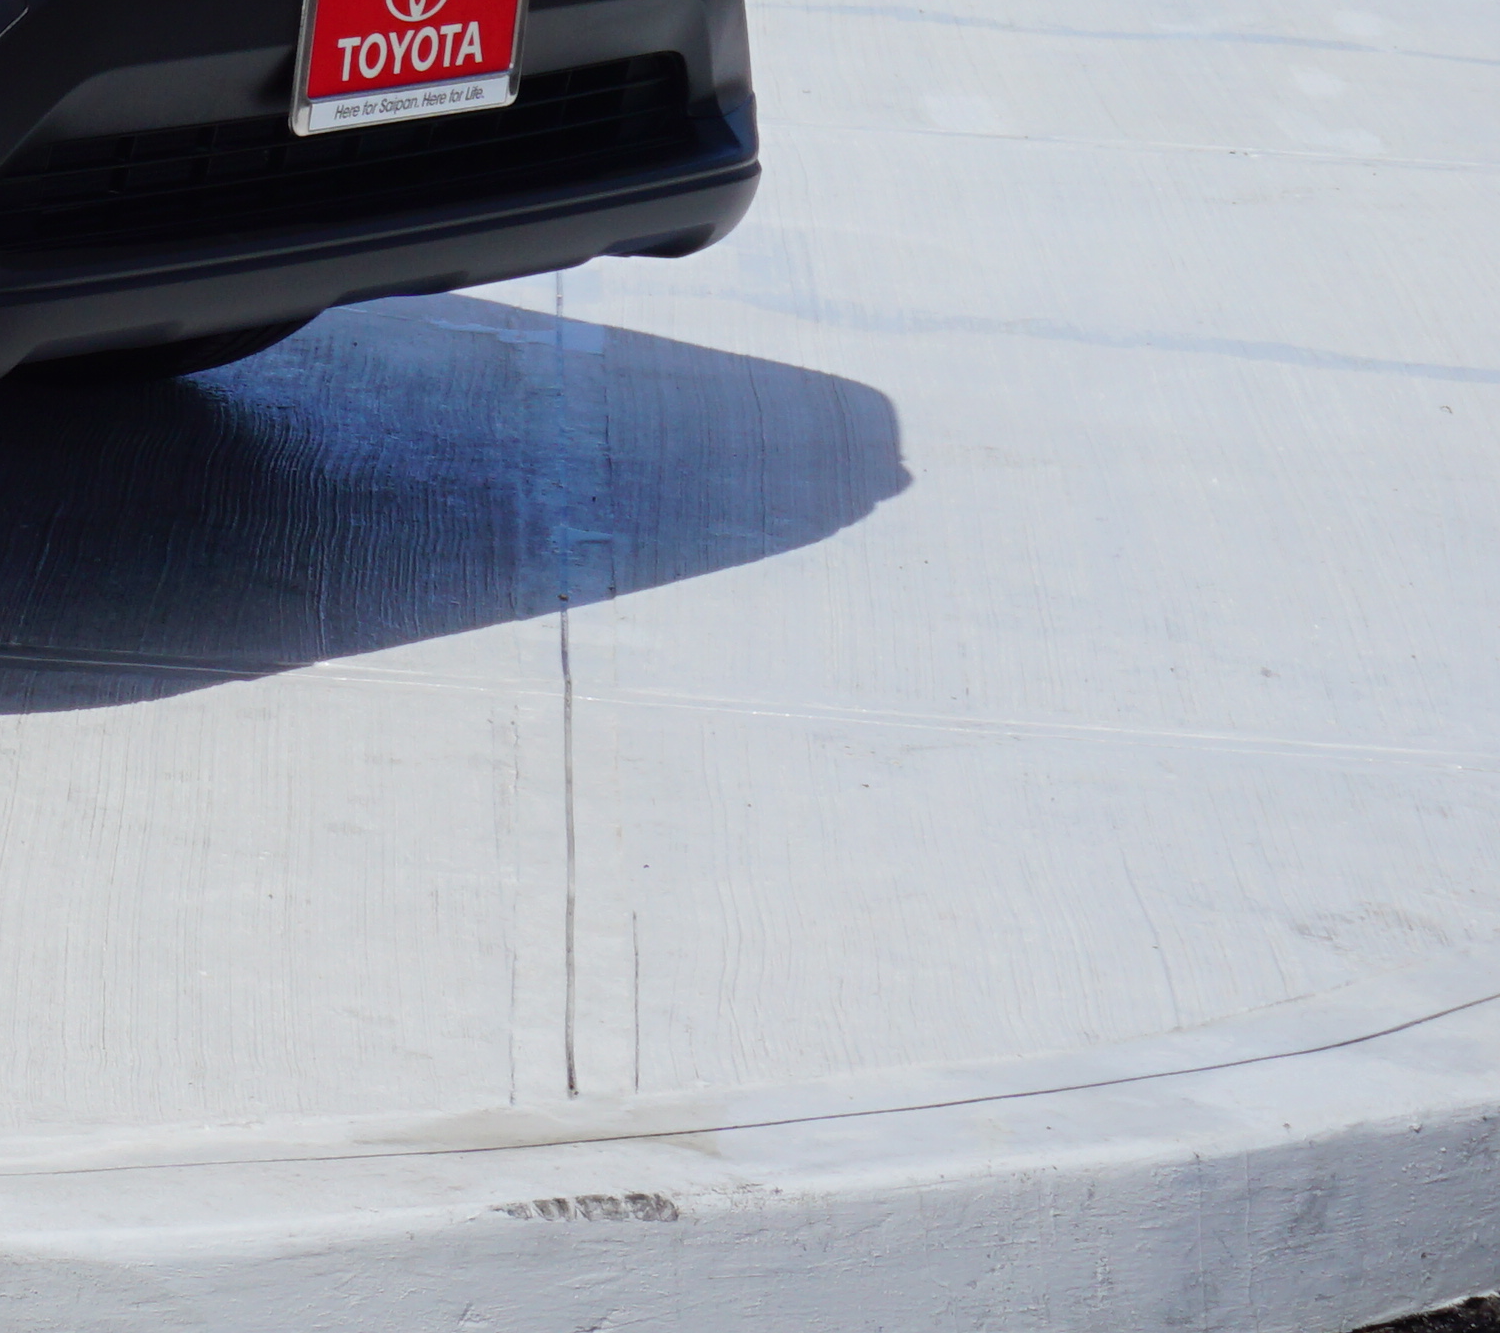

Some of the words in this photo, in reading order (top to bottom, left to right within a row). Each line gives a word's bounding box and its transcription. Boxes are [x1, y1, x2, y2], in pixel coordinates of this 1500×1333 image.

[338, 21, 483, 82] TOYOTA
[334, 105, 360, 120] Here
[362, 102, 378, 116] for
[379, 95, 419, 115] Saipan.
[422, 92, 447, 108] Here
[449, 89, 465, 104] for
[465, 86, 485, 101] Life.
